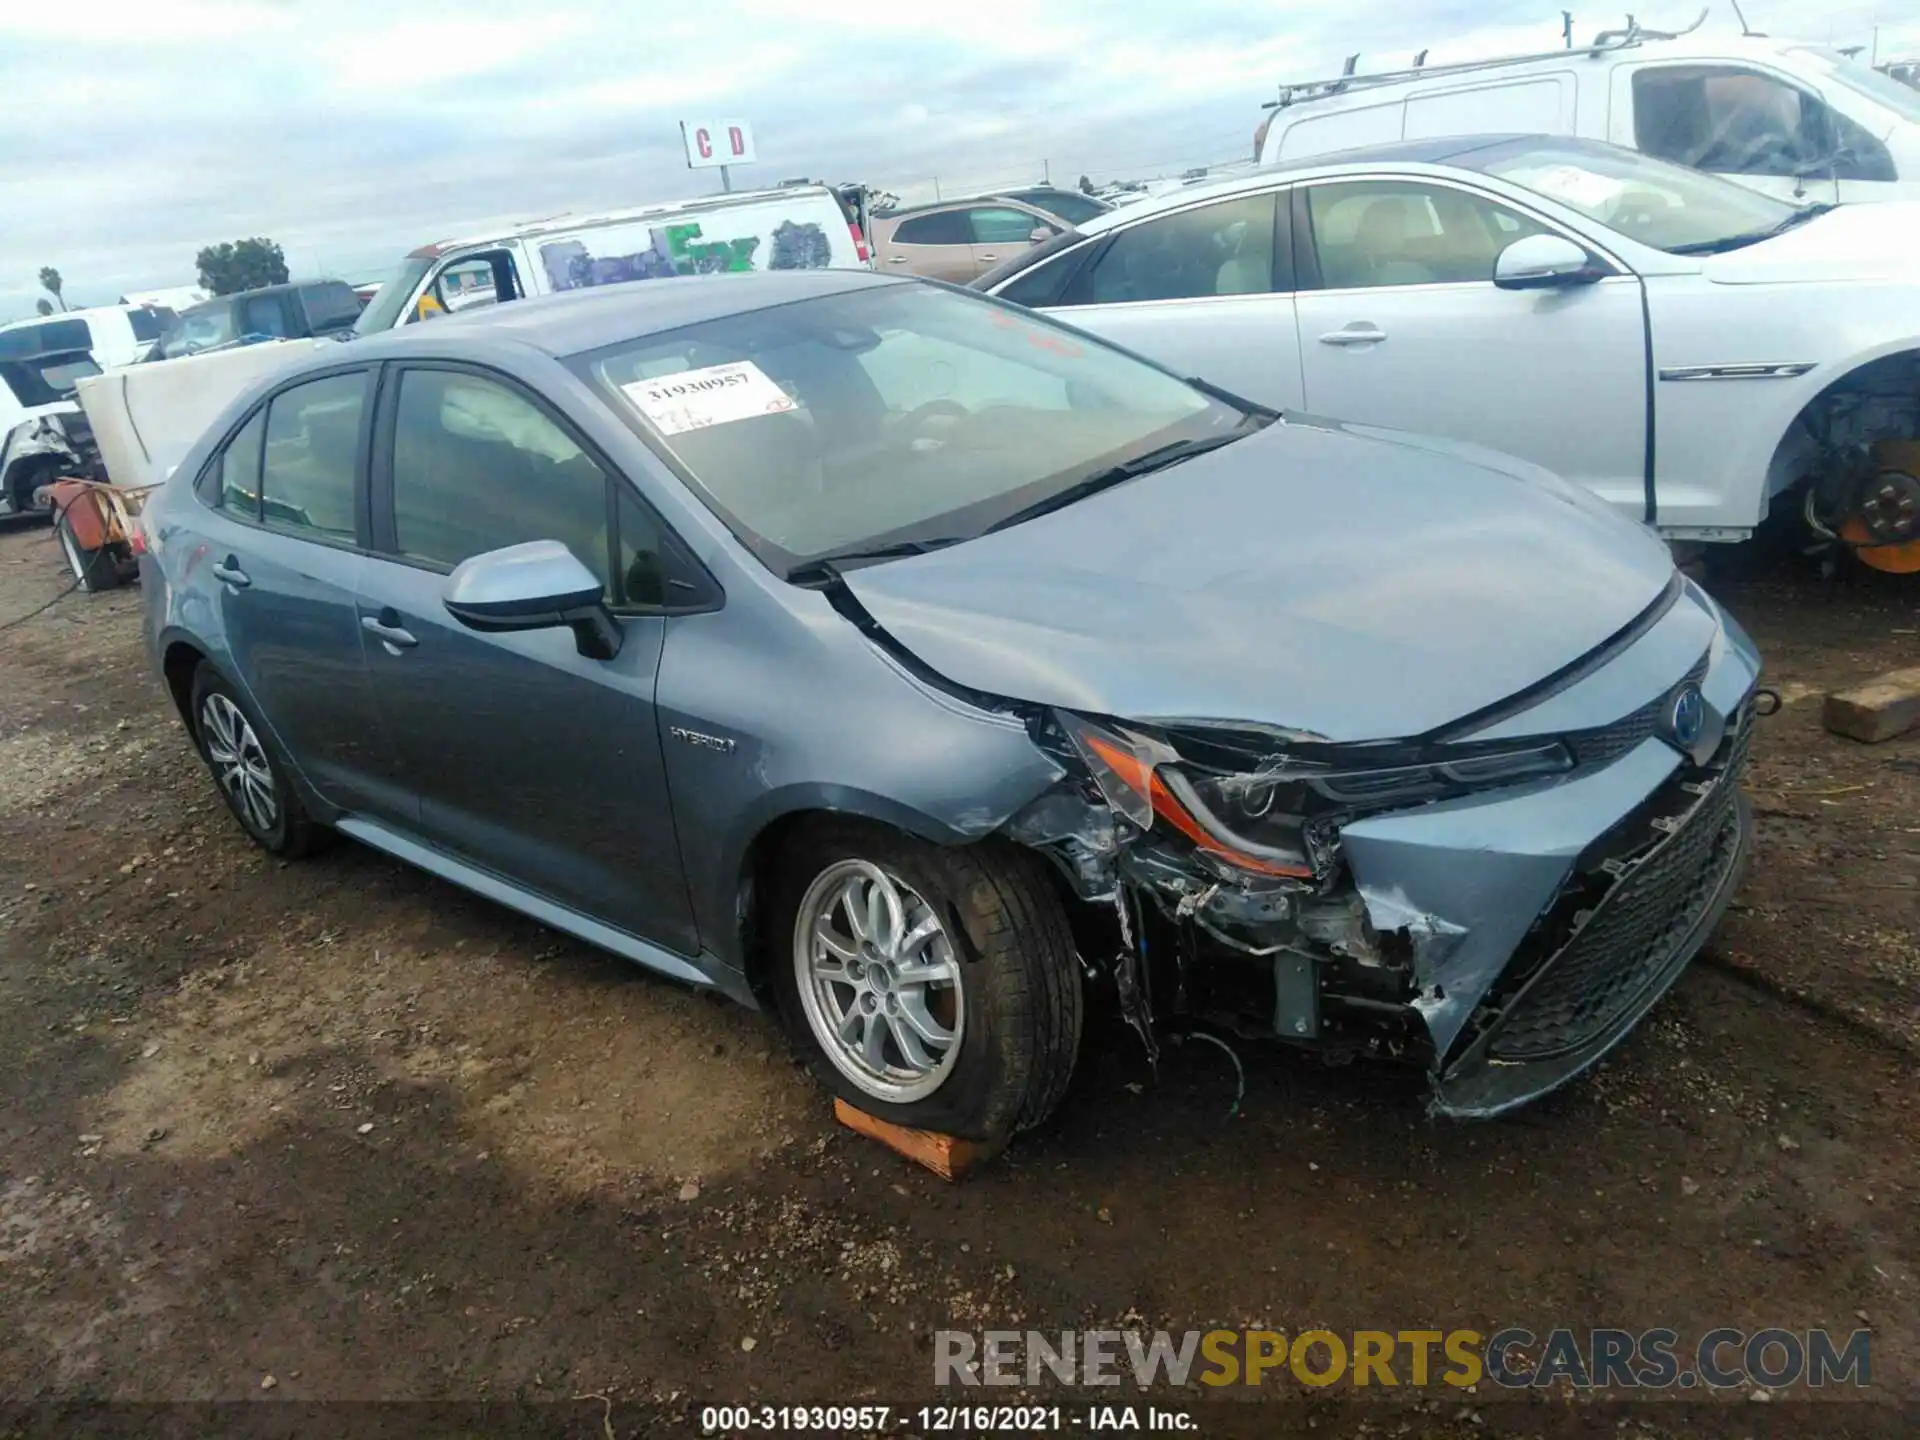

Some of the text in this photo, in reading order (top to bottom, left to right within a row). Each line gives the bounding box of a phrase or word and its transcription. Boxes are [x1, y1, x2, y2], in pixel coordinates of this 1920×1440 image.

[696, 126, 744, 158] C D
[649, 372, 749, 402] 31930957
